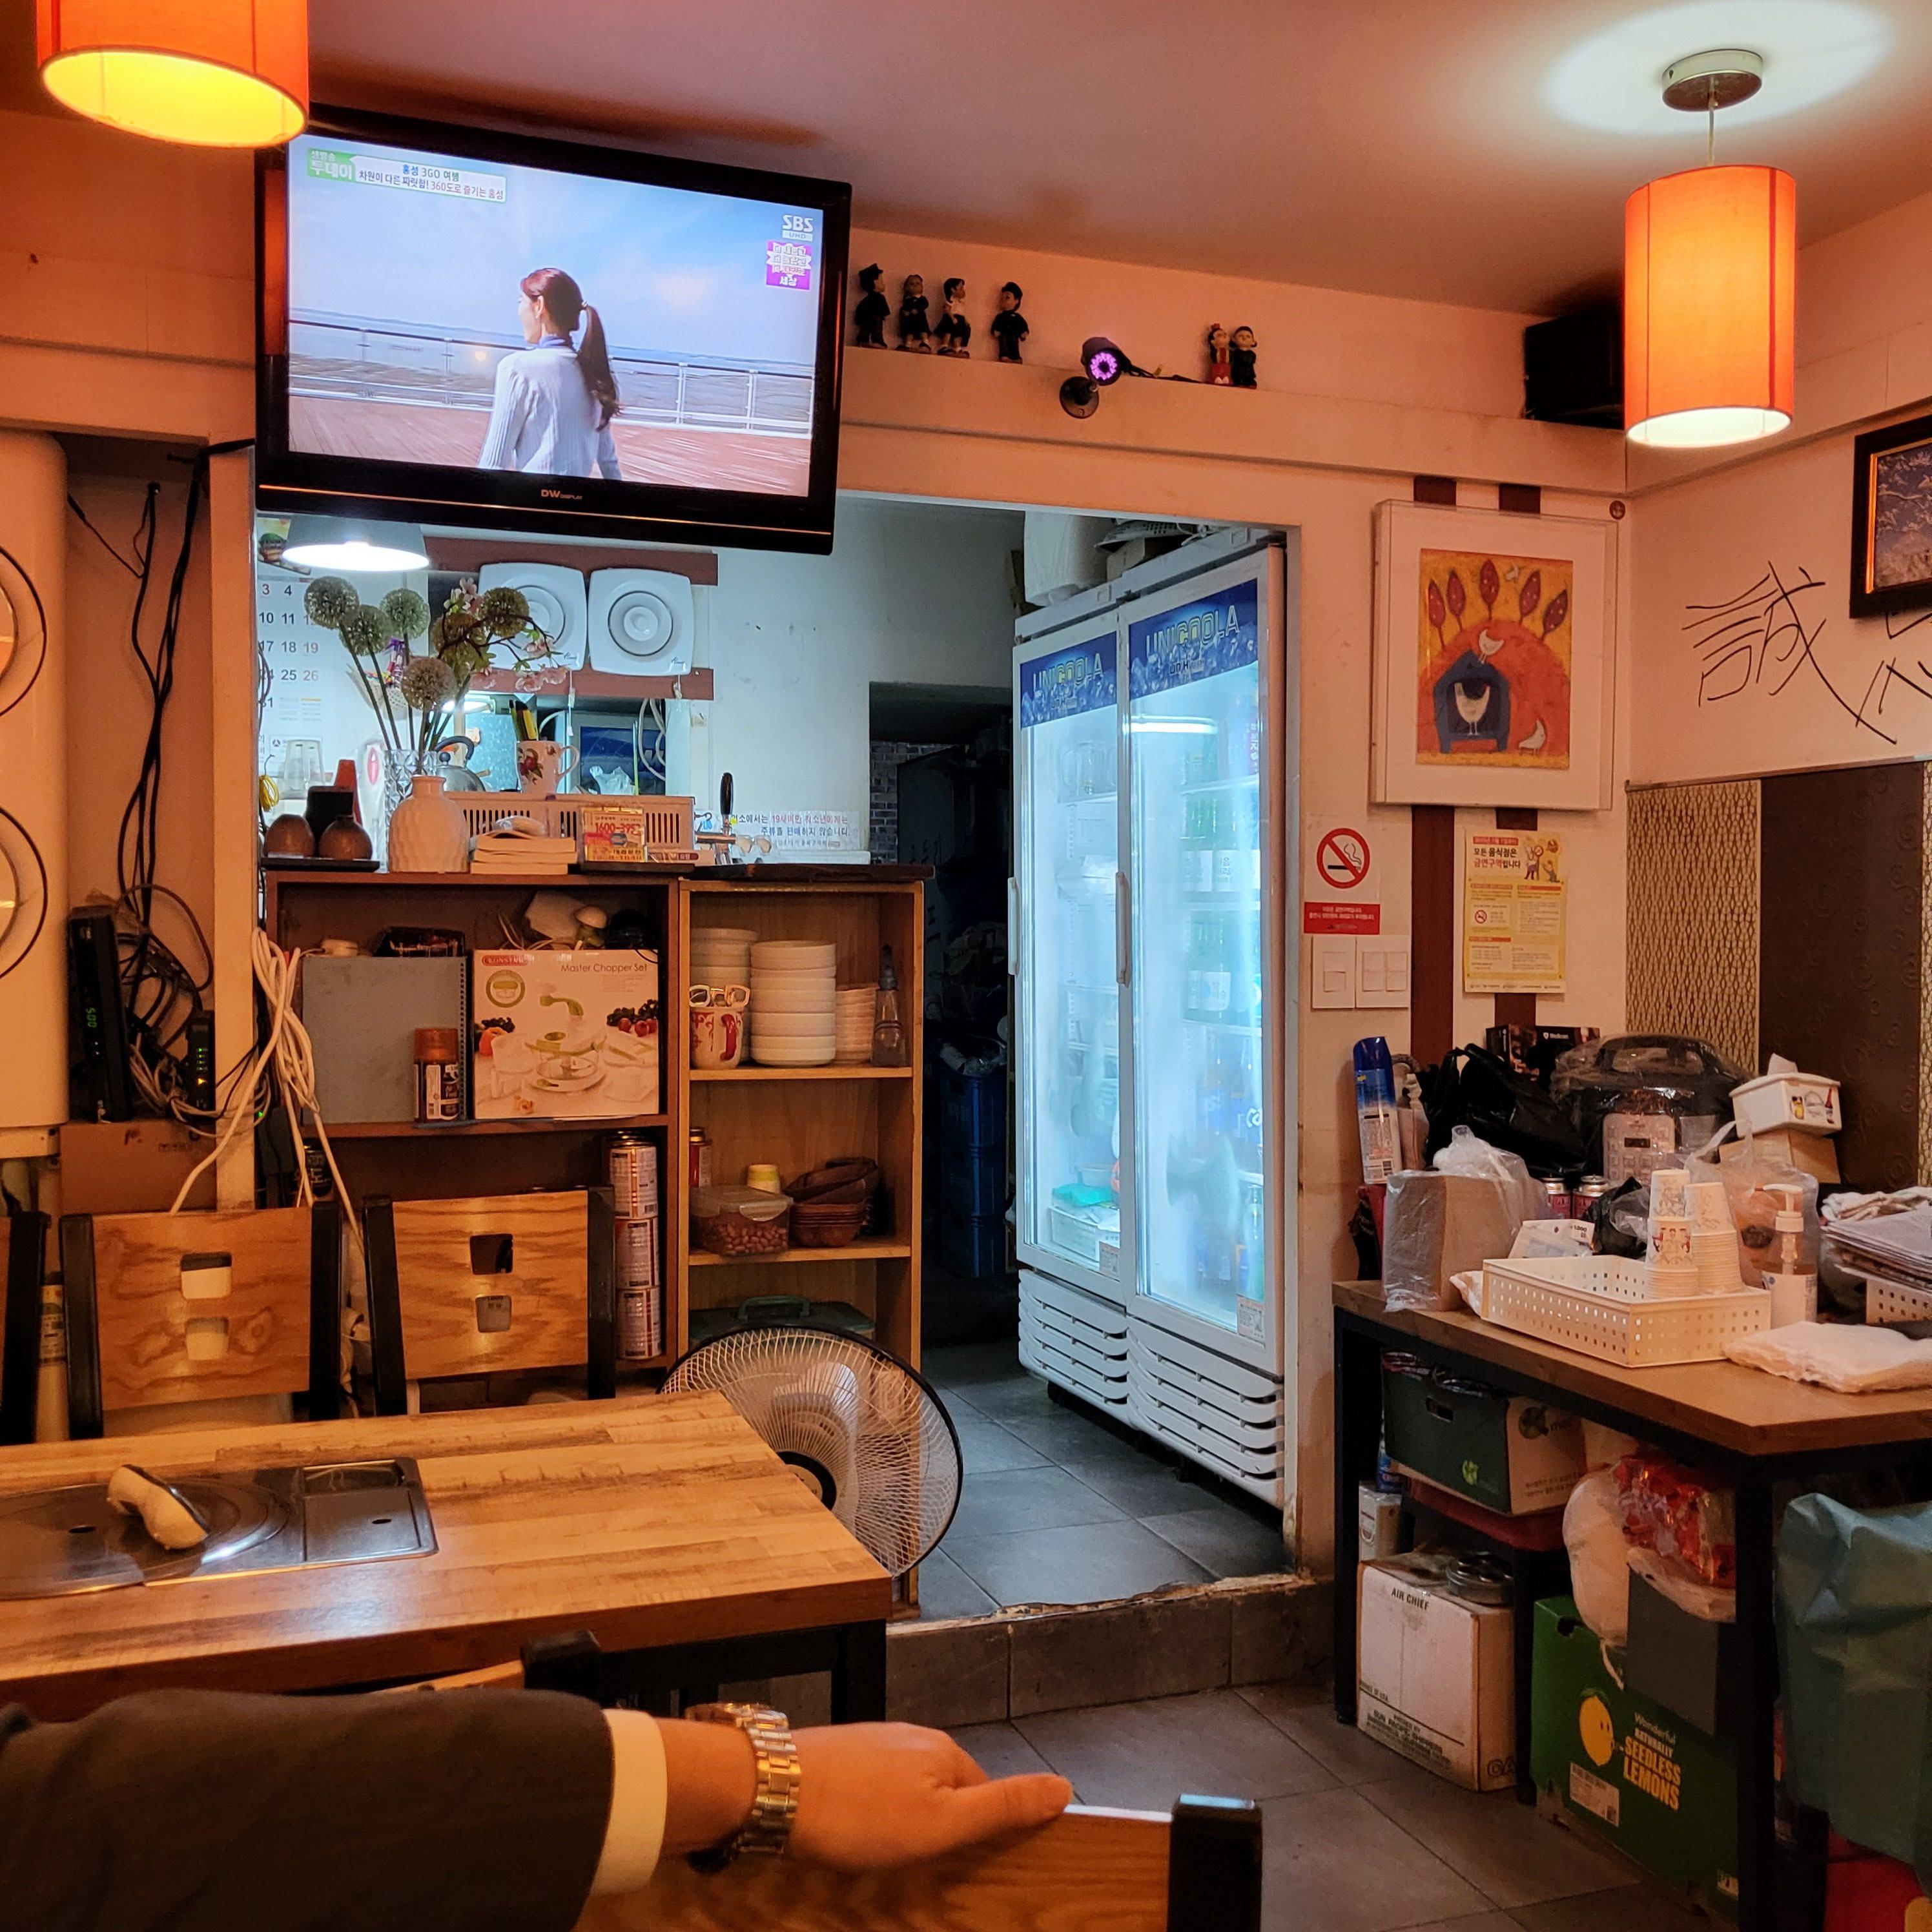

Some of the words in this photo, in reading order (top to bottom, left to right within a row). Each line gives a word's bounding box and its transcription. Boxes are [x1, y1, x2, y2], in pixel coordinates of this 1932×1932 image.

[310, 159, 353, 180] 투데이
[402, 164, 419, 176] 홍성
[422, 167, 440, 179] 3GO
[443, 170, 459, 182] 여행
[359, 170, 383, 183] 차원이
[385, 174, 401, 185] 다른
[431, 181, 461, 194] 360도로
[464, 185, 486, 198] 즐기는
[488, 188, 504, 200] 홍성
[783, 214, 814, 232] SBS
[540, 489, 560, 498] DW
[262, 584, 270, 595] 3
[284, 585, 293, 596] 4
[259, 612, 274, 624] 10
[282, 613, 294, 625] 11
[260, 641, 274, 653] 17
[281, 641, 296, 653] 18
[303, 642, 318, 654] 19
[281, 669, 297, 681] 25
[303, 670, 319, 682] 26
[772, 814, 802, 824] 19세미만
[787, 827, 816, 836] 판매하지
[1474, 847, 1486, 857] 모든
[1488, 847, 1517, 858] 음식점은
[1474, 858, 1521, 869] 금연구역입니다
[561, 964, 586, 972] Master
[593, 963, 632, 974] Chopper
[1391, 1588, 1404, 1601] AIR
[1406, 1594, 1429, 1610] CHIEF
[1625, 1735, 1680, 1786] SEEDLESS
[1623, 1755, 1680, 1811] LEMONS
